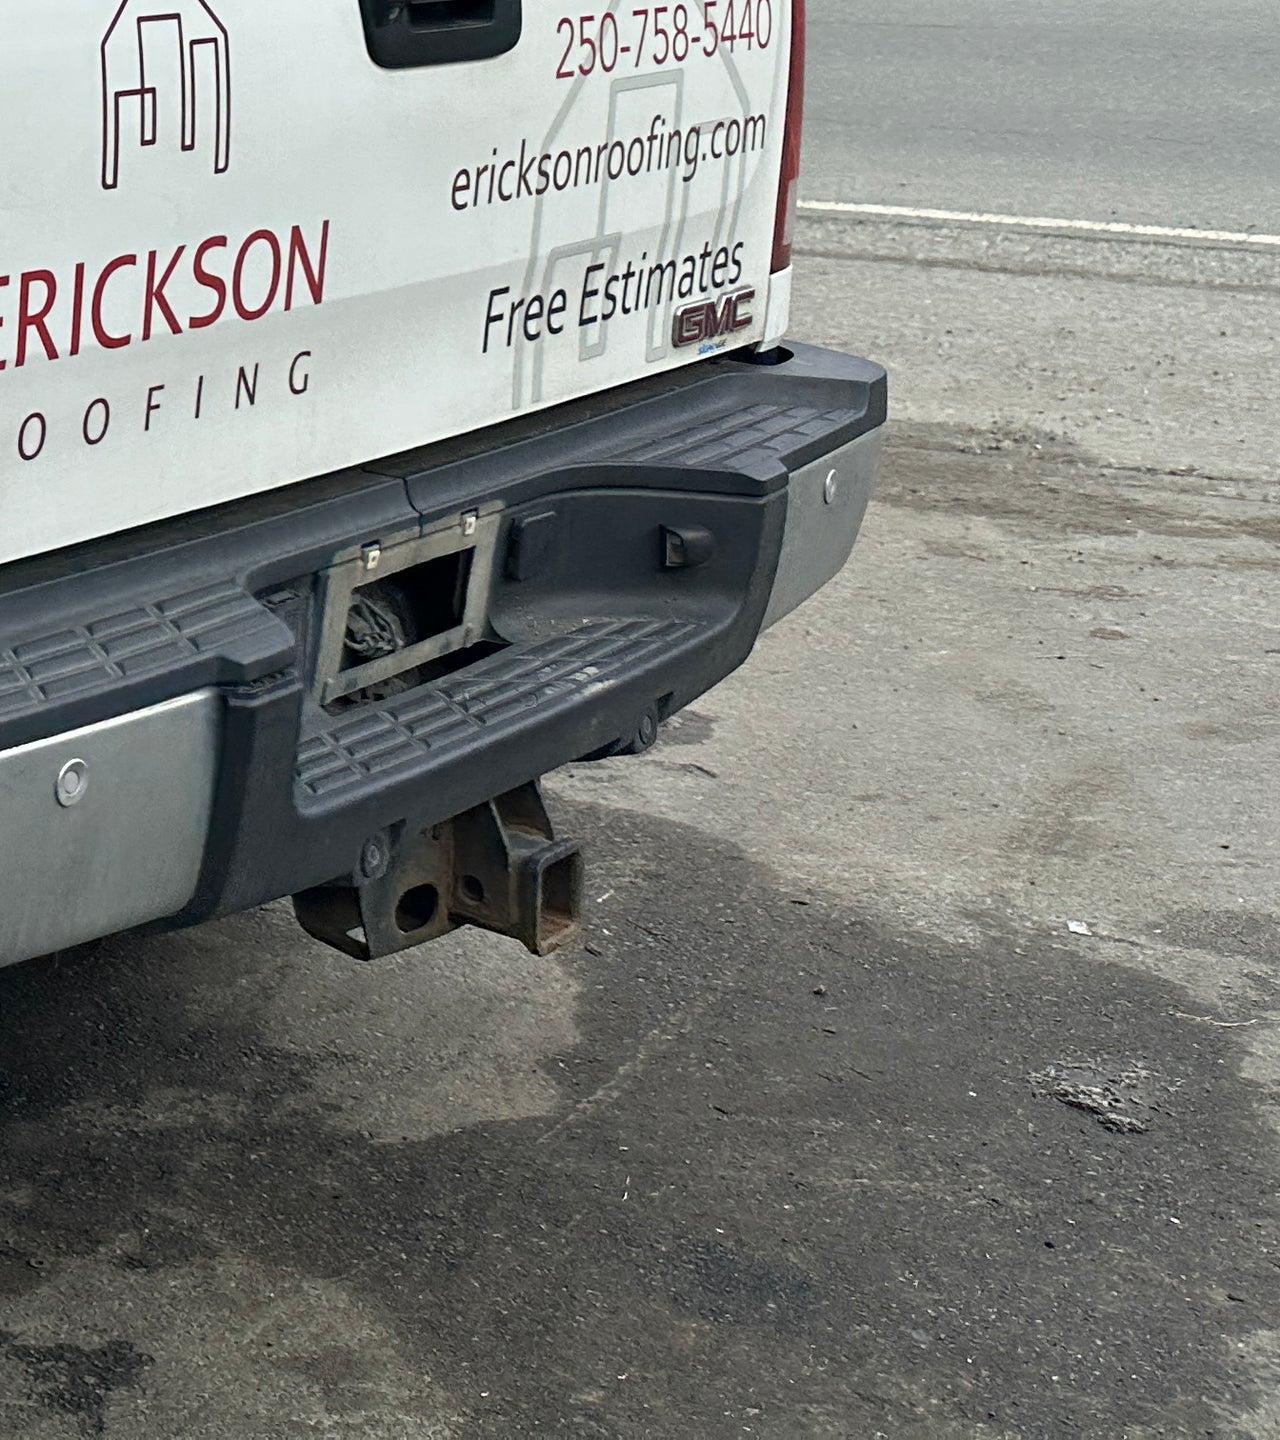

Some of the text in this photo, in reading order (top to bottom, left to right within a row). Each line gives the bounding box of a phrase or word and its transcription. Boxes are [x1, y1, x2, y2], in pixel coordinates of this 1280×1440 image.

[451, 112, 766, 212] ericksonroofing.com
[482, 240, 744, 354] Free Estimates
[672, 284, 756, 348] GMC
